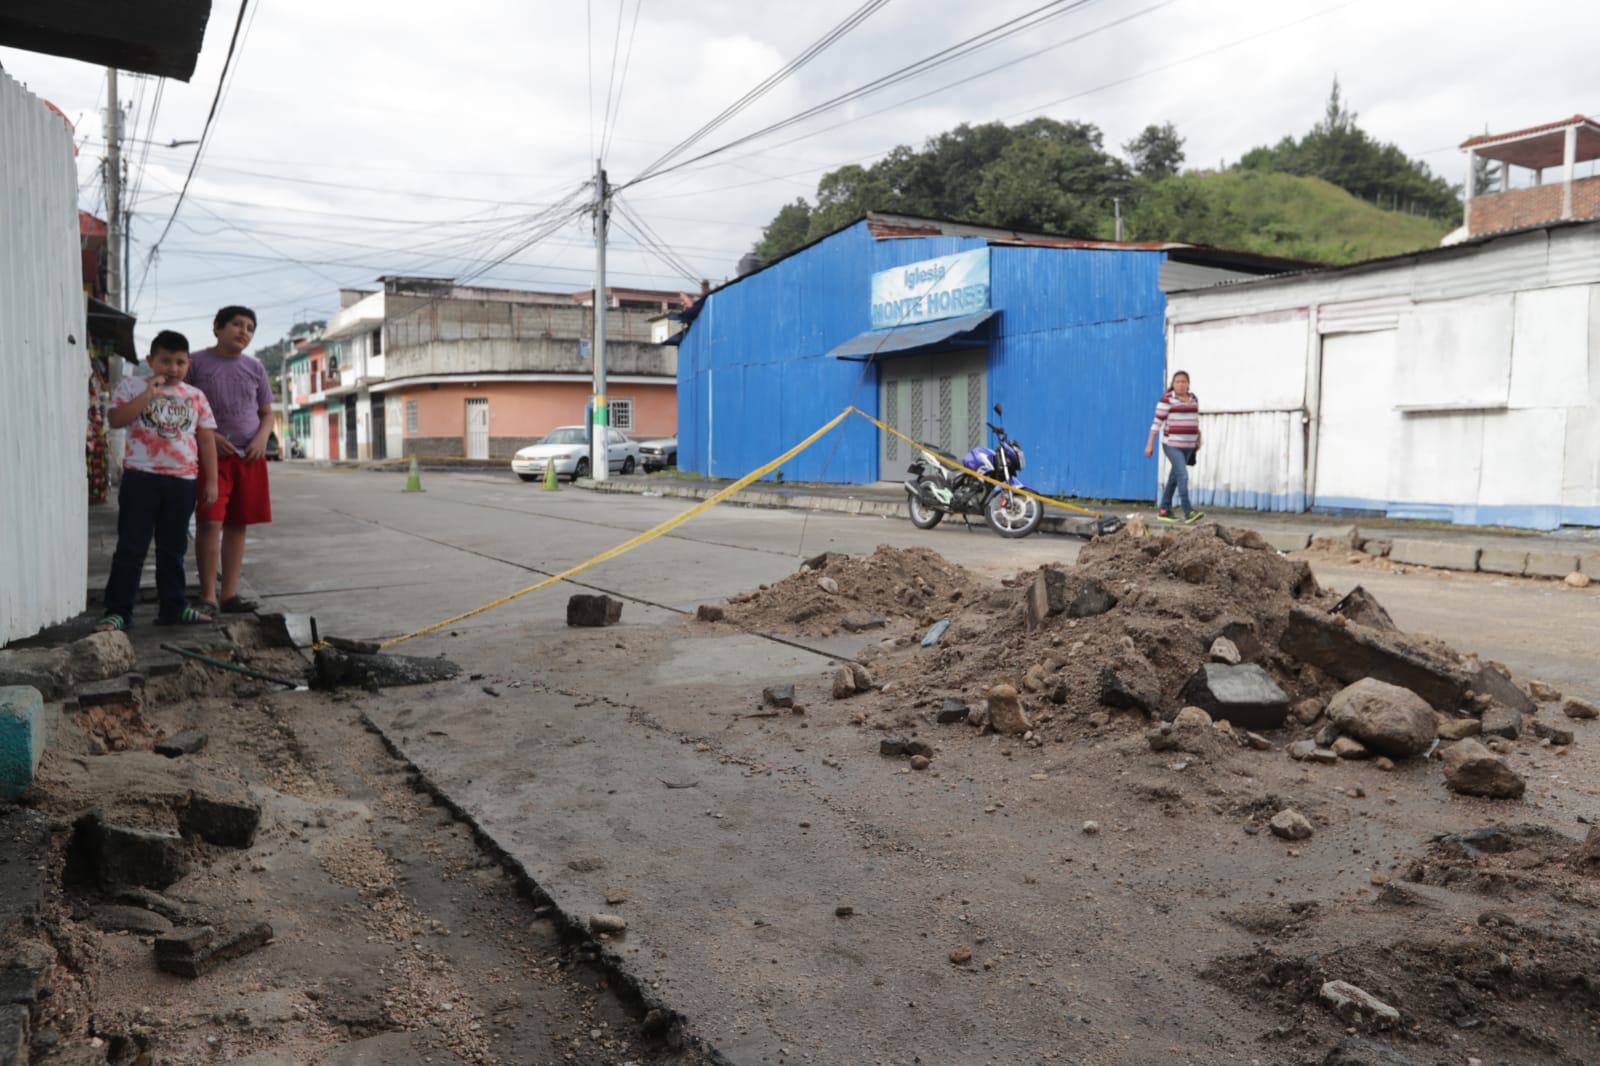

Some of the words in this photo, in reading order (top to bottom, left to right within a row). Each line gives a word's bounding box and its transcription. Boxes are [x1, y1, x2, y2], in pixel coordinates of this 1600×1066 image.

[904, 264, 945, 289] Iglesia
[872, 296, 923, 322] MONTE
[927, 284, 988, 314] HOREB
